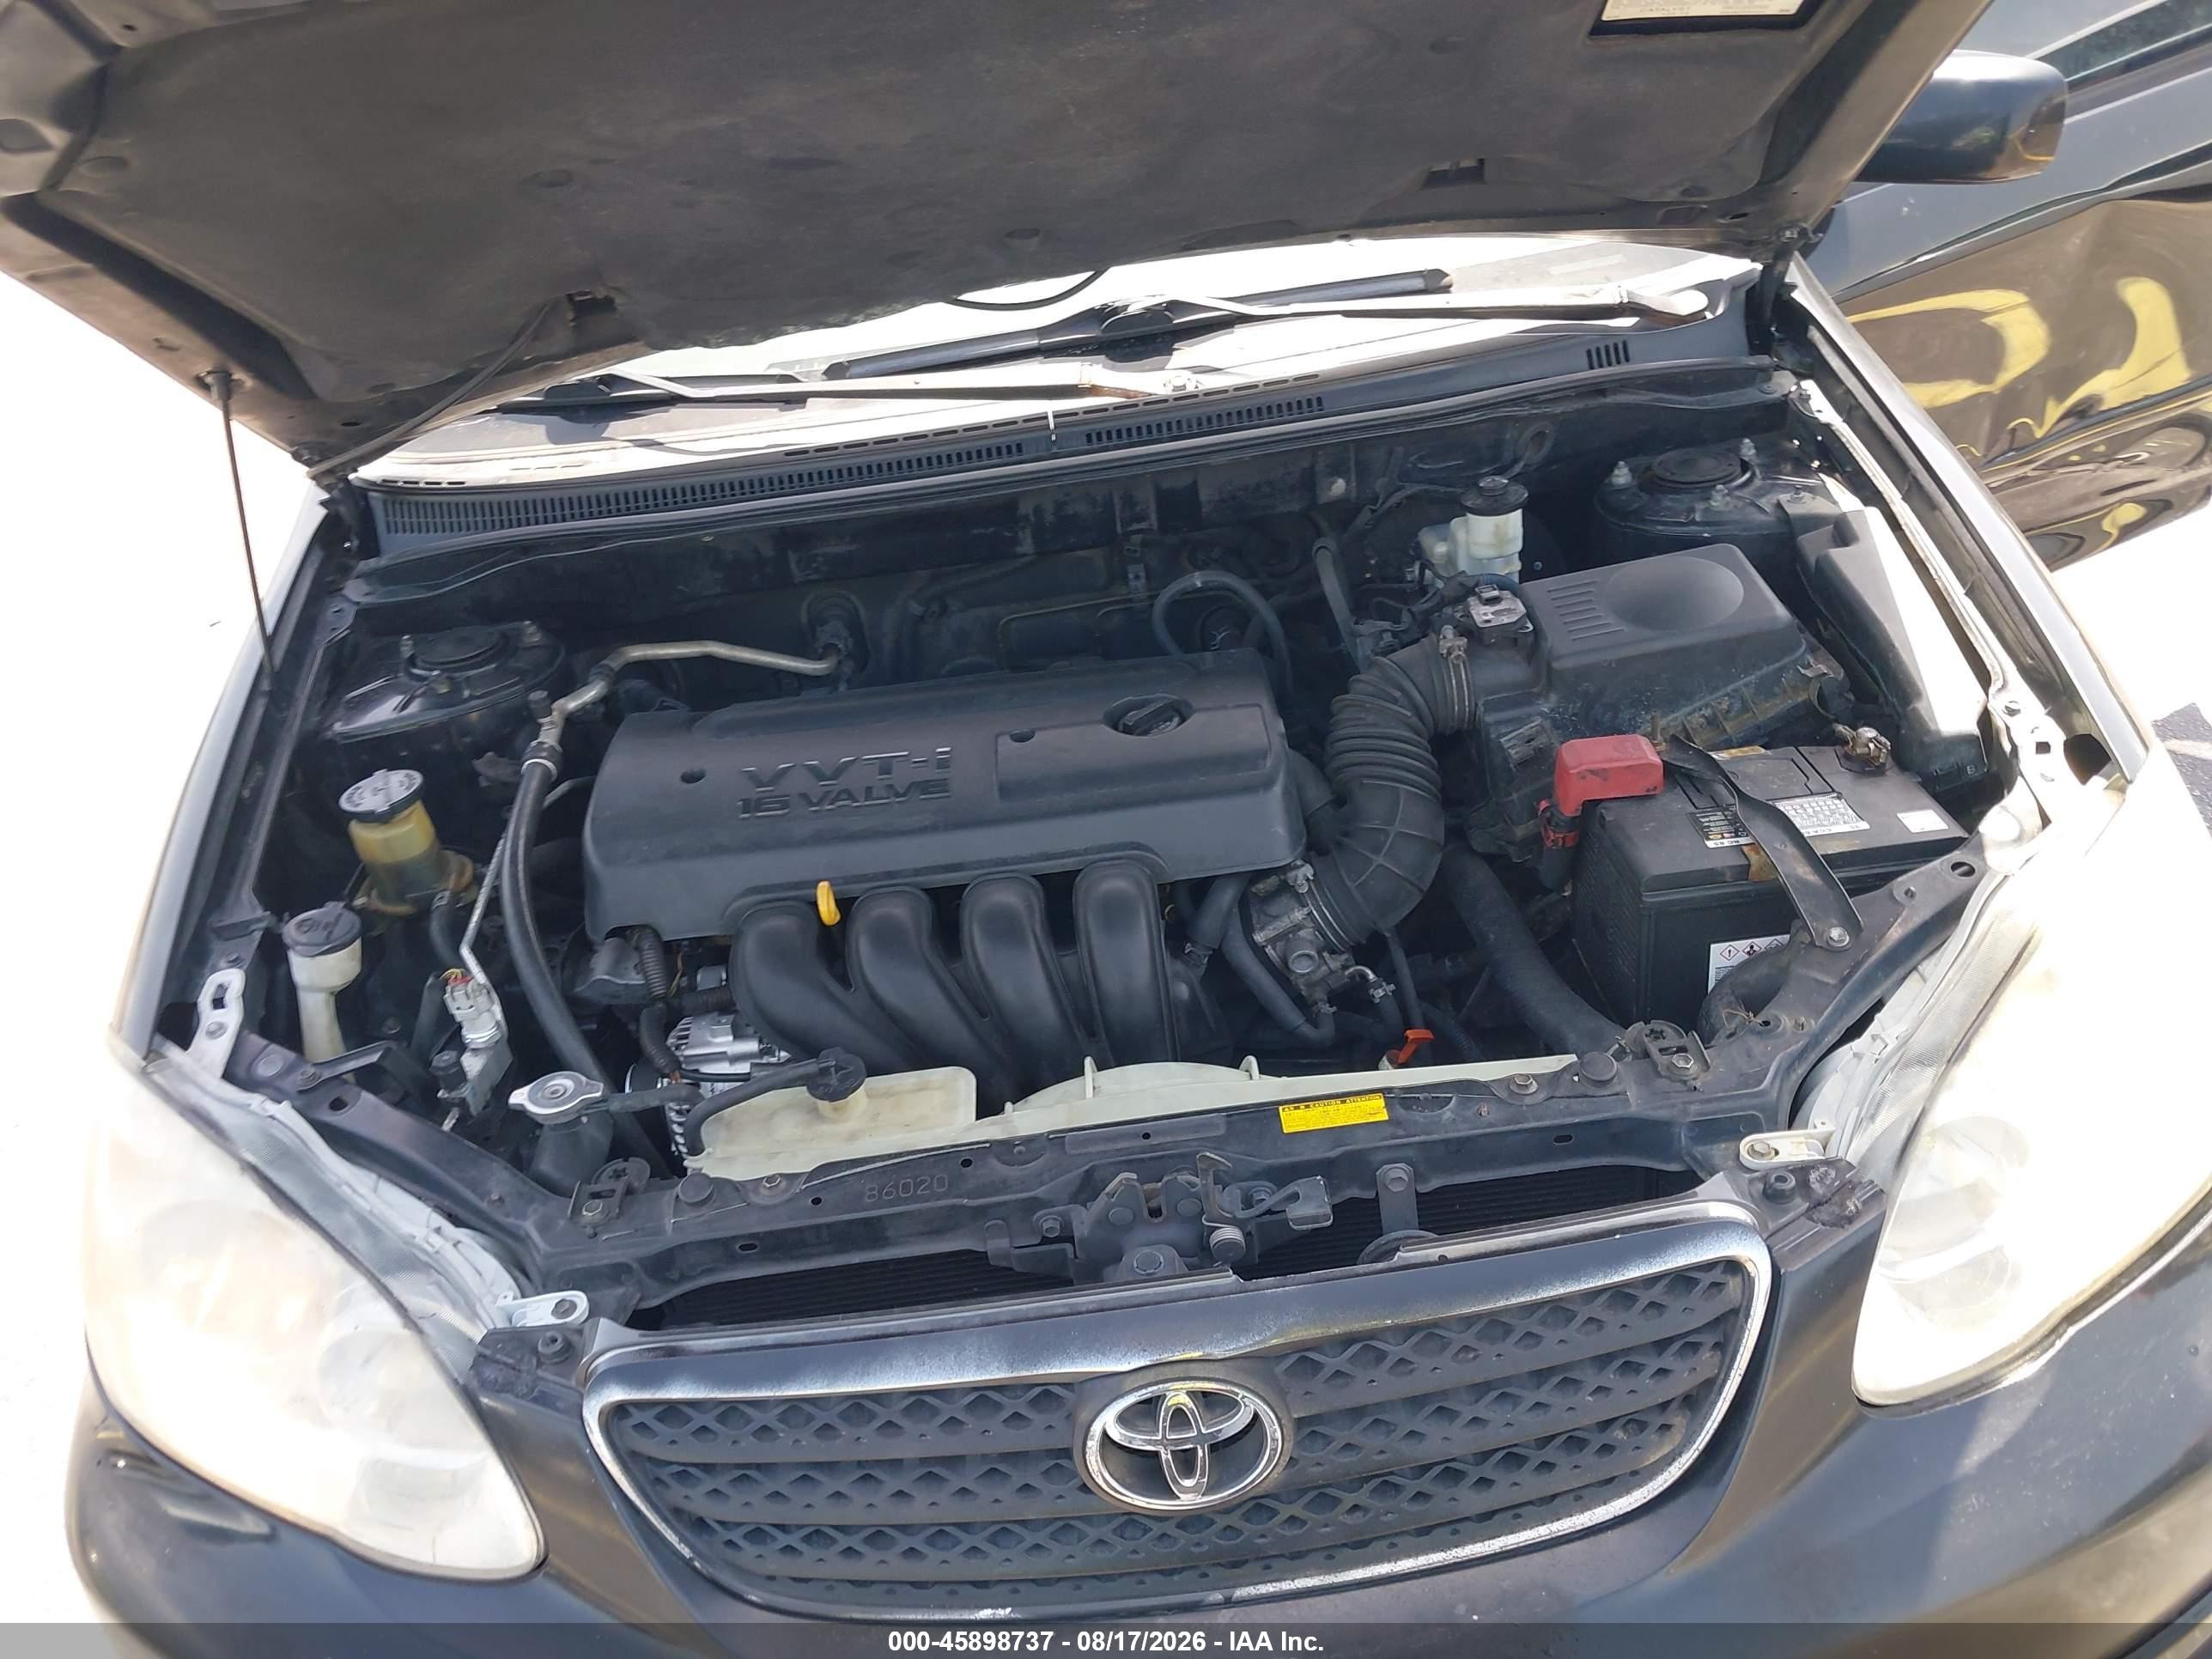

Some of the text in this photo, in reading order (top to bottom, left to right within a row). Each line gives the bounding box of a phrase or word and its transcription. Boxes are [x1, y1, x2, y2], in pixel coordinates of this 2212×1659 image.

[741, 747, 951, 792] VVT-i
[737, 778, 951, 818] 16 VALVE
[1310, 1100, 1341, 1109] CAUTION
[1346, 1095, 1381, 1104] ATTENTION
[866, 1174, 949, 1202] 86020
